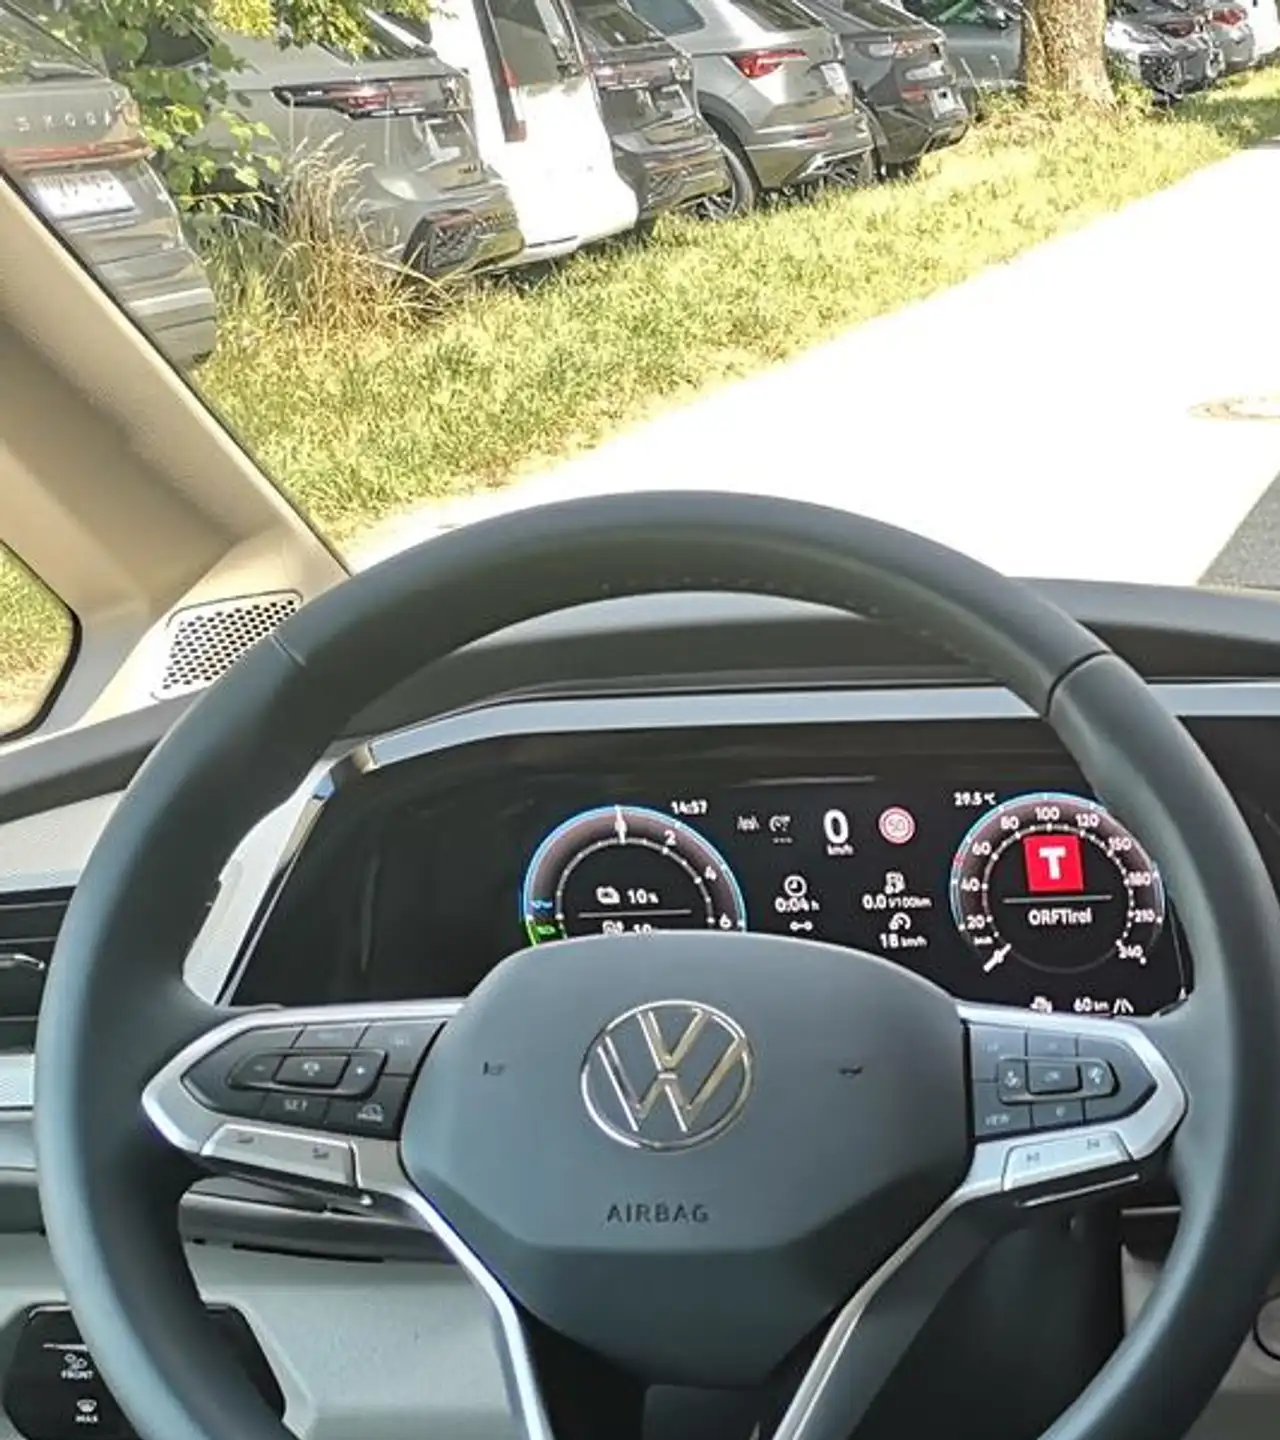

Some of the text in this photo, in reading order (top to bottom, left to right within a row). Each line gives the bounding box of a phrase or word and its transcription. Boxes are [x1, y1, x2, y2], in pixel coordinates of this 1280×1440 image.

[671, 801, 707, 814] 14:57
[1034, 807, 1060, 821] 100
[823, 809, 848, 844] 0
[1001, 815, 1019, 831] 80
[1076, 814, 1099, 828] 120
[664, 830, 676, 845] 2
[1108, 836, 1132, 851] 150
[972, 841, 991, 856] 60
[705, 866, 717, 881] 4
[961, 876, 980, 892] 40
[627, 888, 647, 904] 10
[719, 914, 732, 929] 6
[967, 915, 985, 930] 20
[1073, 996, 1092, 1012] 60
[606, 1203, 709, 1224] AIRBAG
